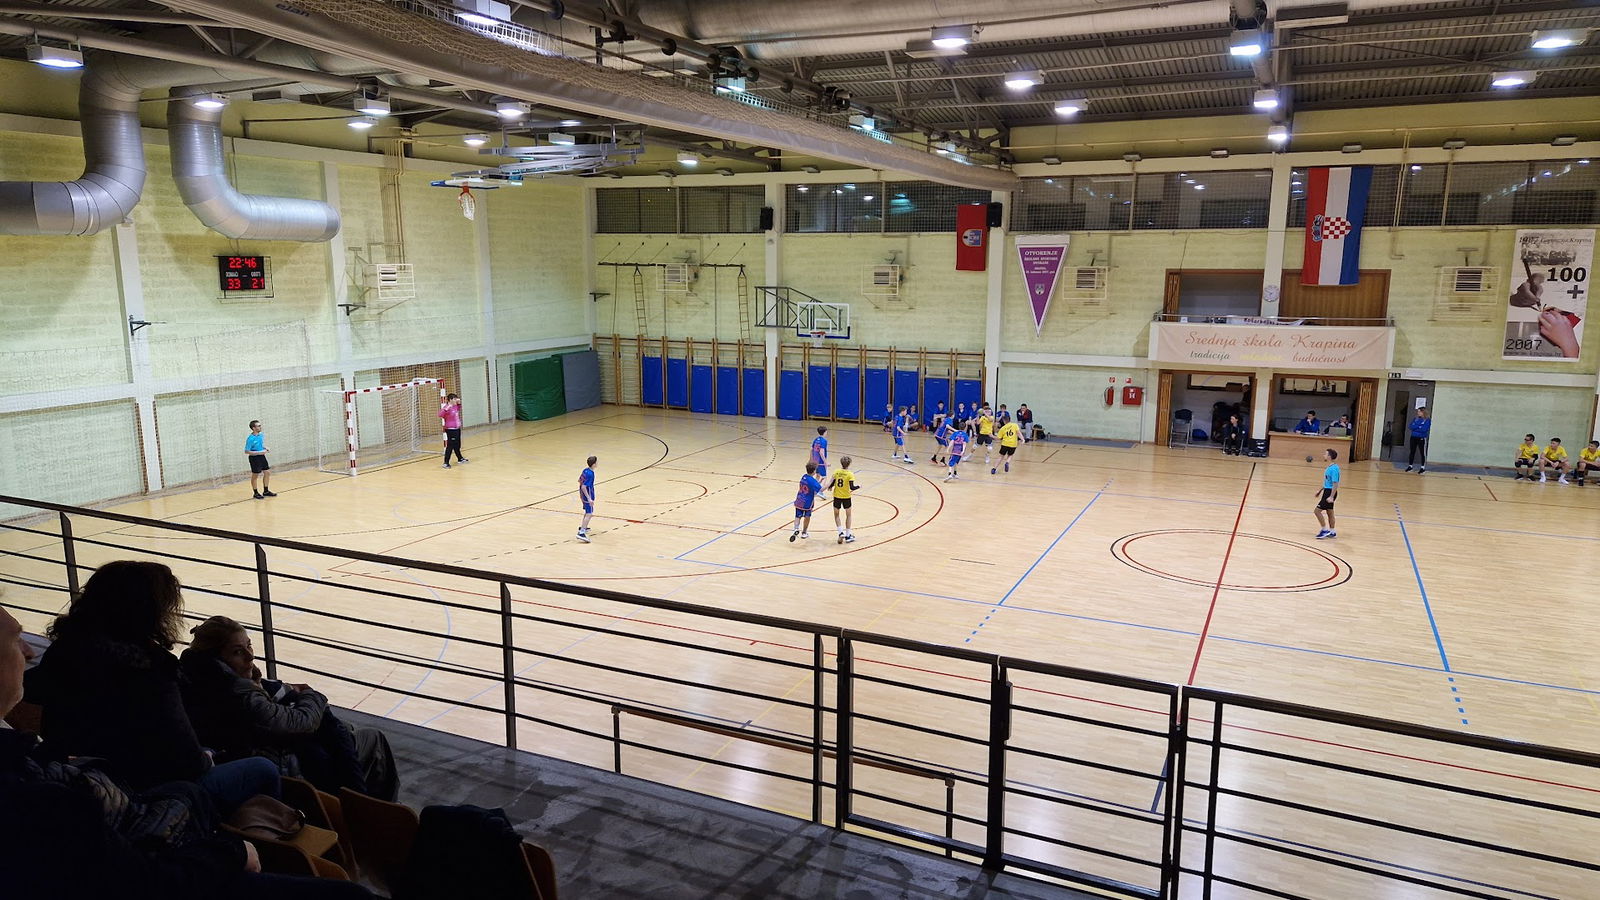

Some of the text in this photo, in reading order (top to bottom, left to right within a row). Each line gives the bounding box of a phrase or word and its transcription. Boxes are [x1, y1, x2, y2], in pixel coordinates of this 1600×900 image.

[228, 257, 257, 268] 22:46
[1547, 267, 1587, 282] 100
[228, 278, 264, 289] 33 21
[1185, 331, 1356, 352] Srednja škola Krapina
[1505, 339, 1542, 350] 2007
[1189, 349, 1231, 361] tradicija
[1292, 352, 1346, 364] budućnost
[1006, 429, 1014, 437] 16
[837, 478, 844, 487] 8
